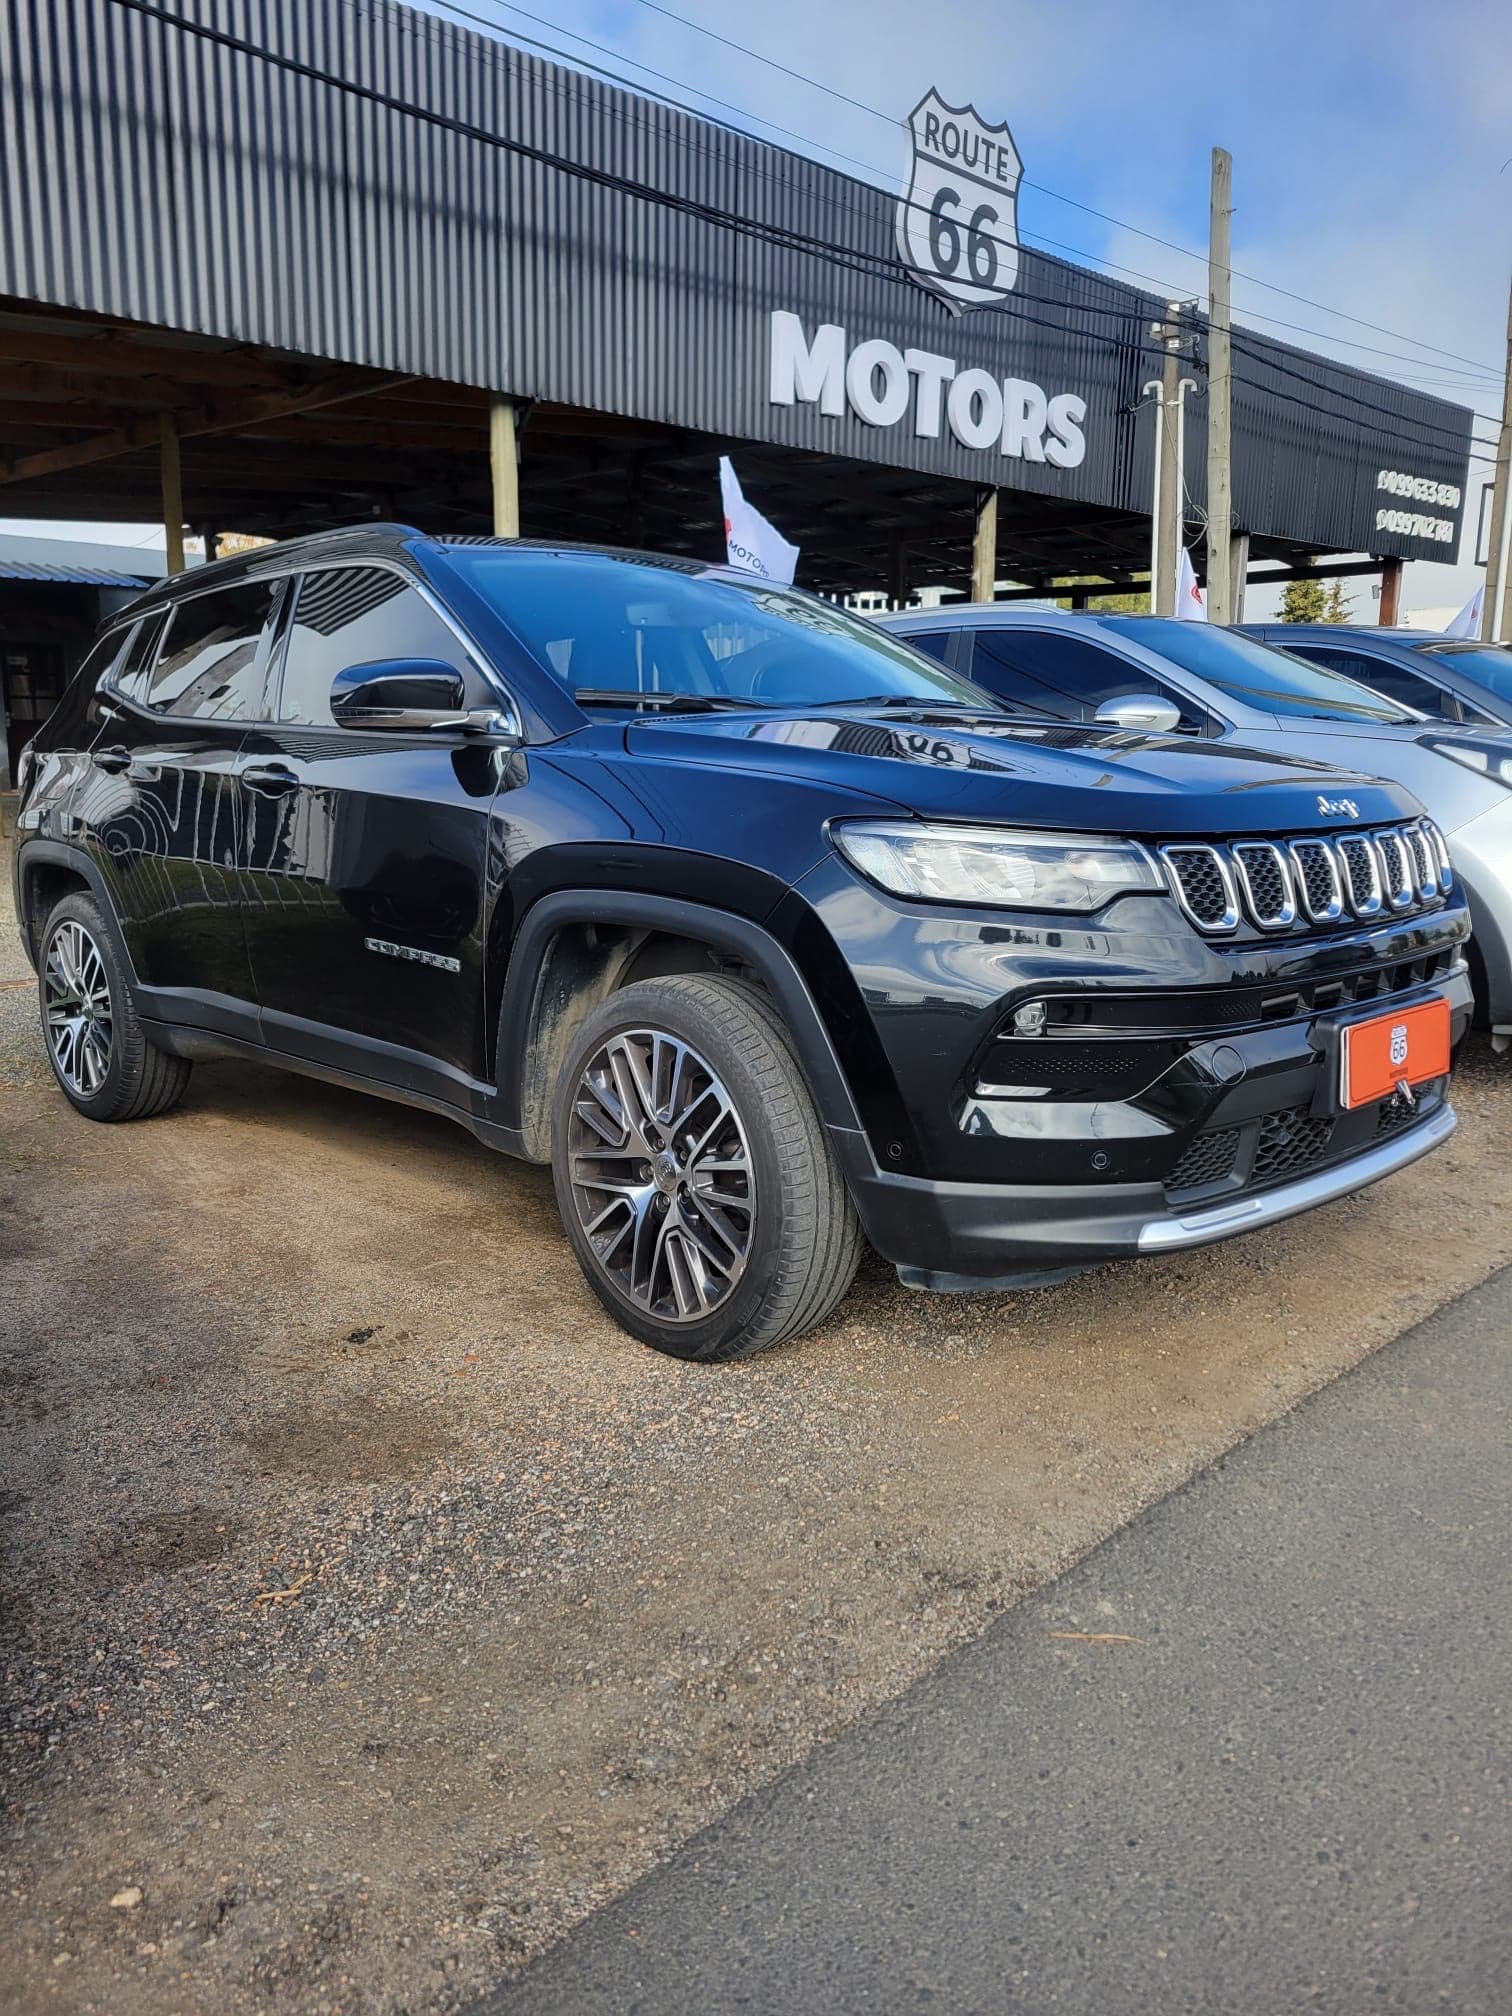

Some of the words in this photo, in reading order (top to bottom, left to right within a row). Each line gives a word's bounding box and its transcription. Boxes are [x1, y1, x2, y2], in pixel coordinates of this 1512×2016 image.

[924, 110, 1009, 182] ROUTE
[929, 186, 999, 288] 66
[770, 310, 1088, 468] MOTORS
[1316, 795, 1360, 819] Jeep
[364, 937, 461, 973] COMPASS
[1392, 1039, 1406, 1061] 66
